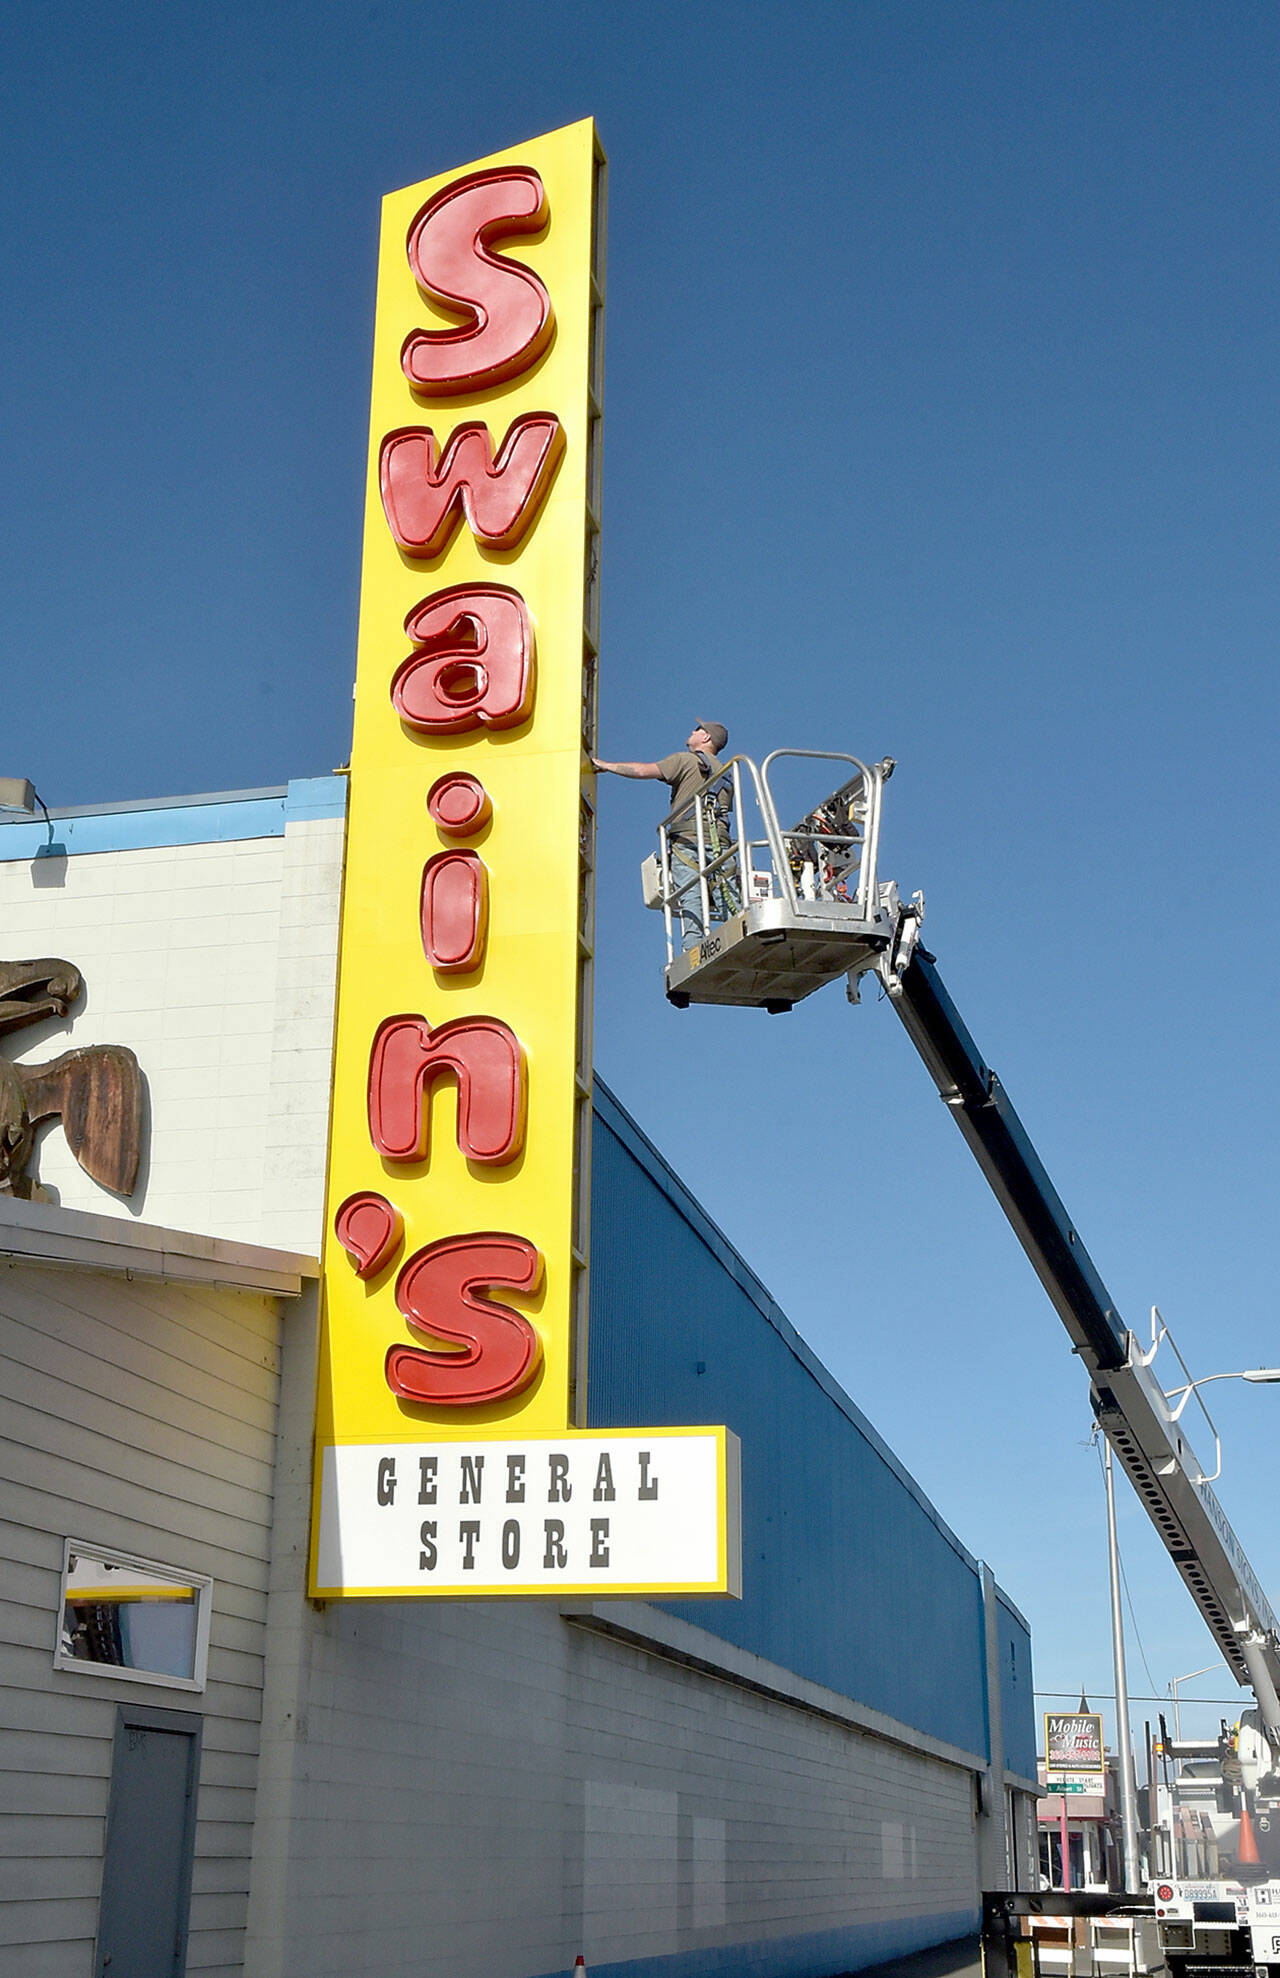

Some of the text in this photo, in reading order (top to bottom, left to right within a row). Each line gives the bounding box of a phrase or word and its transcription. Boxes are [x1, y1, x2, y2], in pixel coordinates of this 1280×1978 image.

[335, 167, 566, 1408] Swain's
[700, 937, 721, 963] Altec
[377, 1452, 658, 1506] GENERAL
[419, 1518, 610, 1570] STORE
[1200, 1484, 1235, 1556] HANSON
[1049, 1720, 1093, 1733] Mobile
[1063, 1733, 1099, 1749] Music
